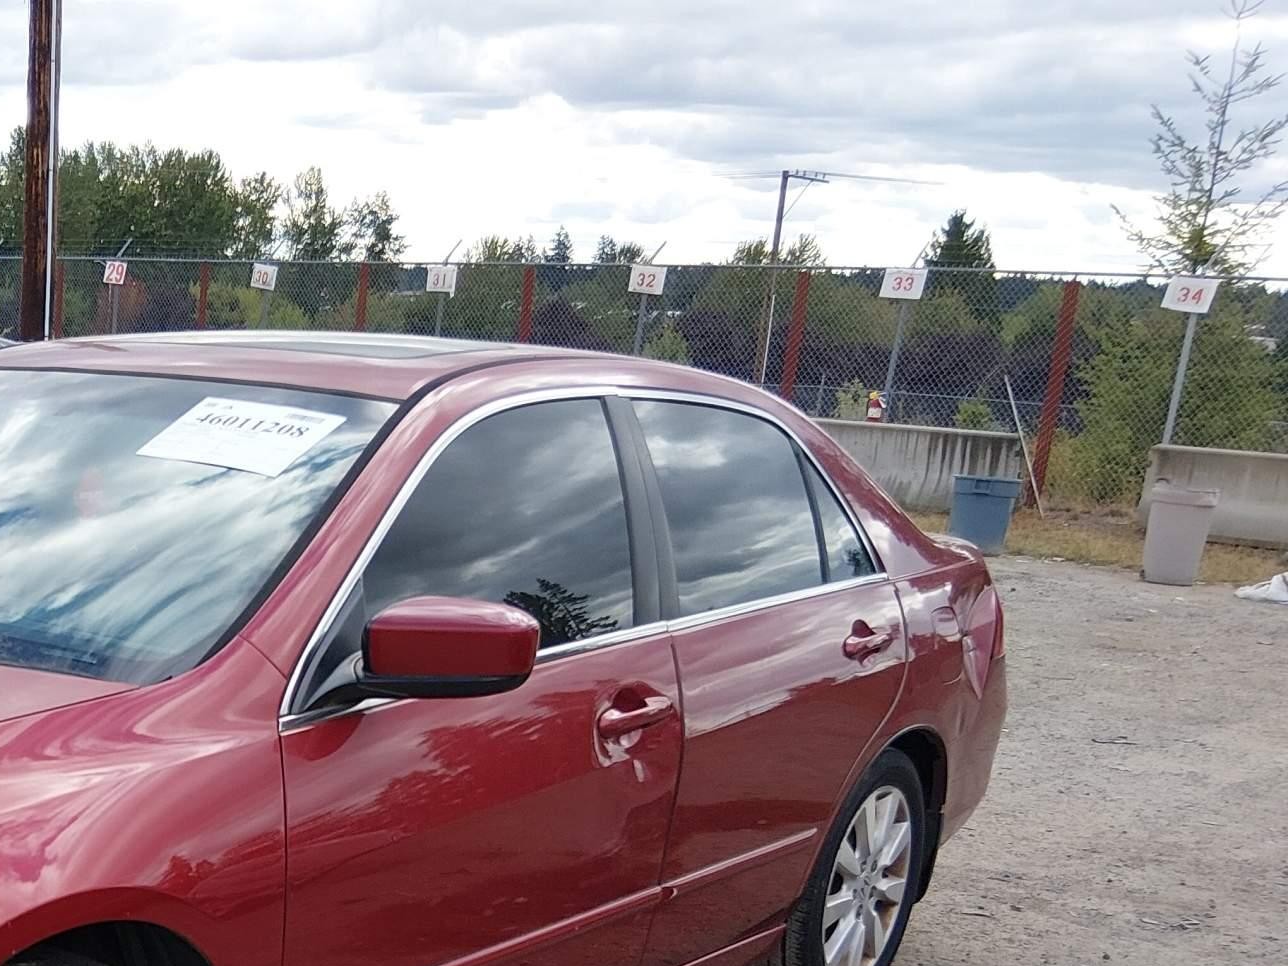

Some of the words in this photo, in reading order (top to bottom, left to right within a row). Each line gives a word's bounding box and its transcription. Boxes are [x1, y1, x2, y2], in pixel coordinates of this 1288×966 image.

[106, 263, 124, 282] 29
[433, 273, 446, 287] 31
[637, 272, 656, 288] 32
[892, 276, 914, 291] 33
[1177, 286, 1204, 304] 34
[196, 412, 309, 438] 46011208
